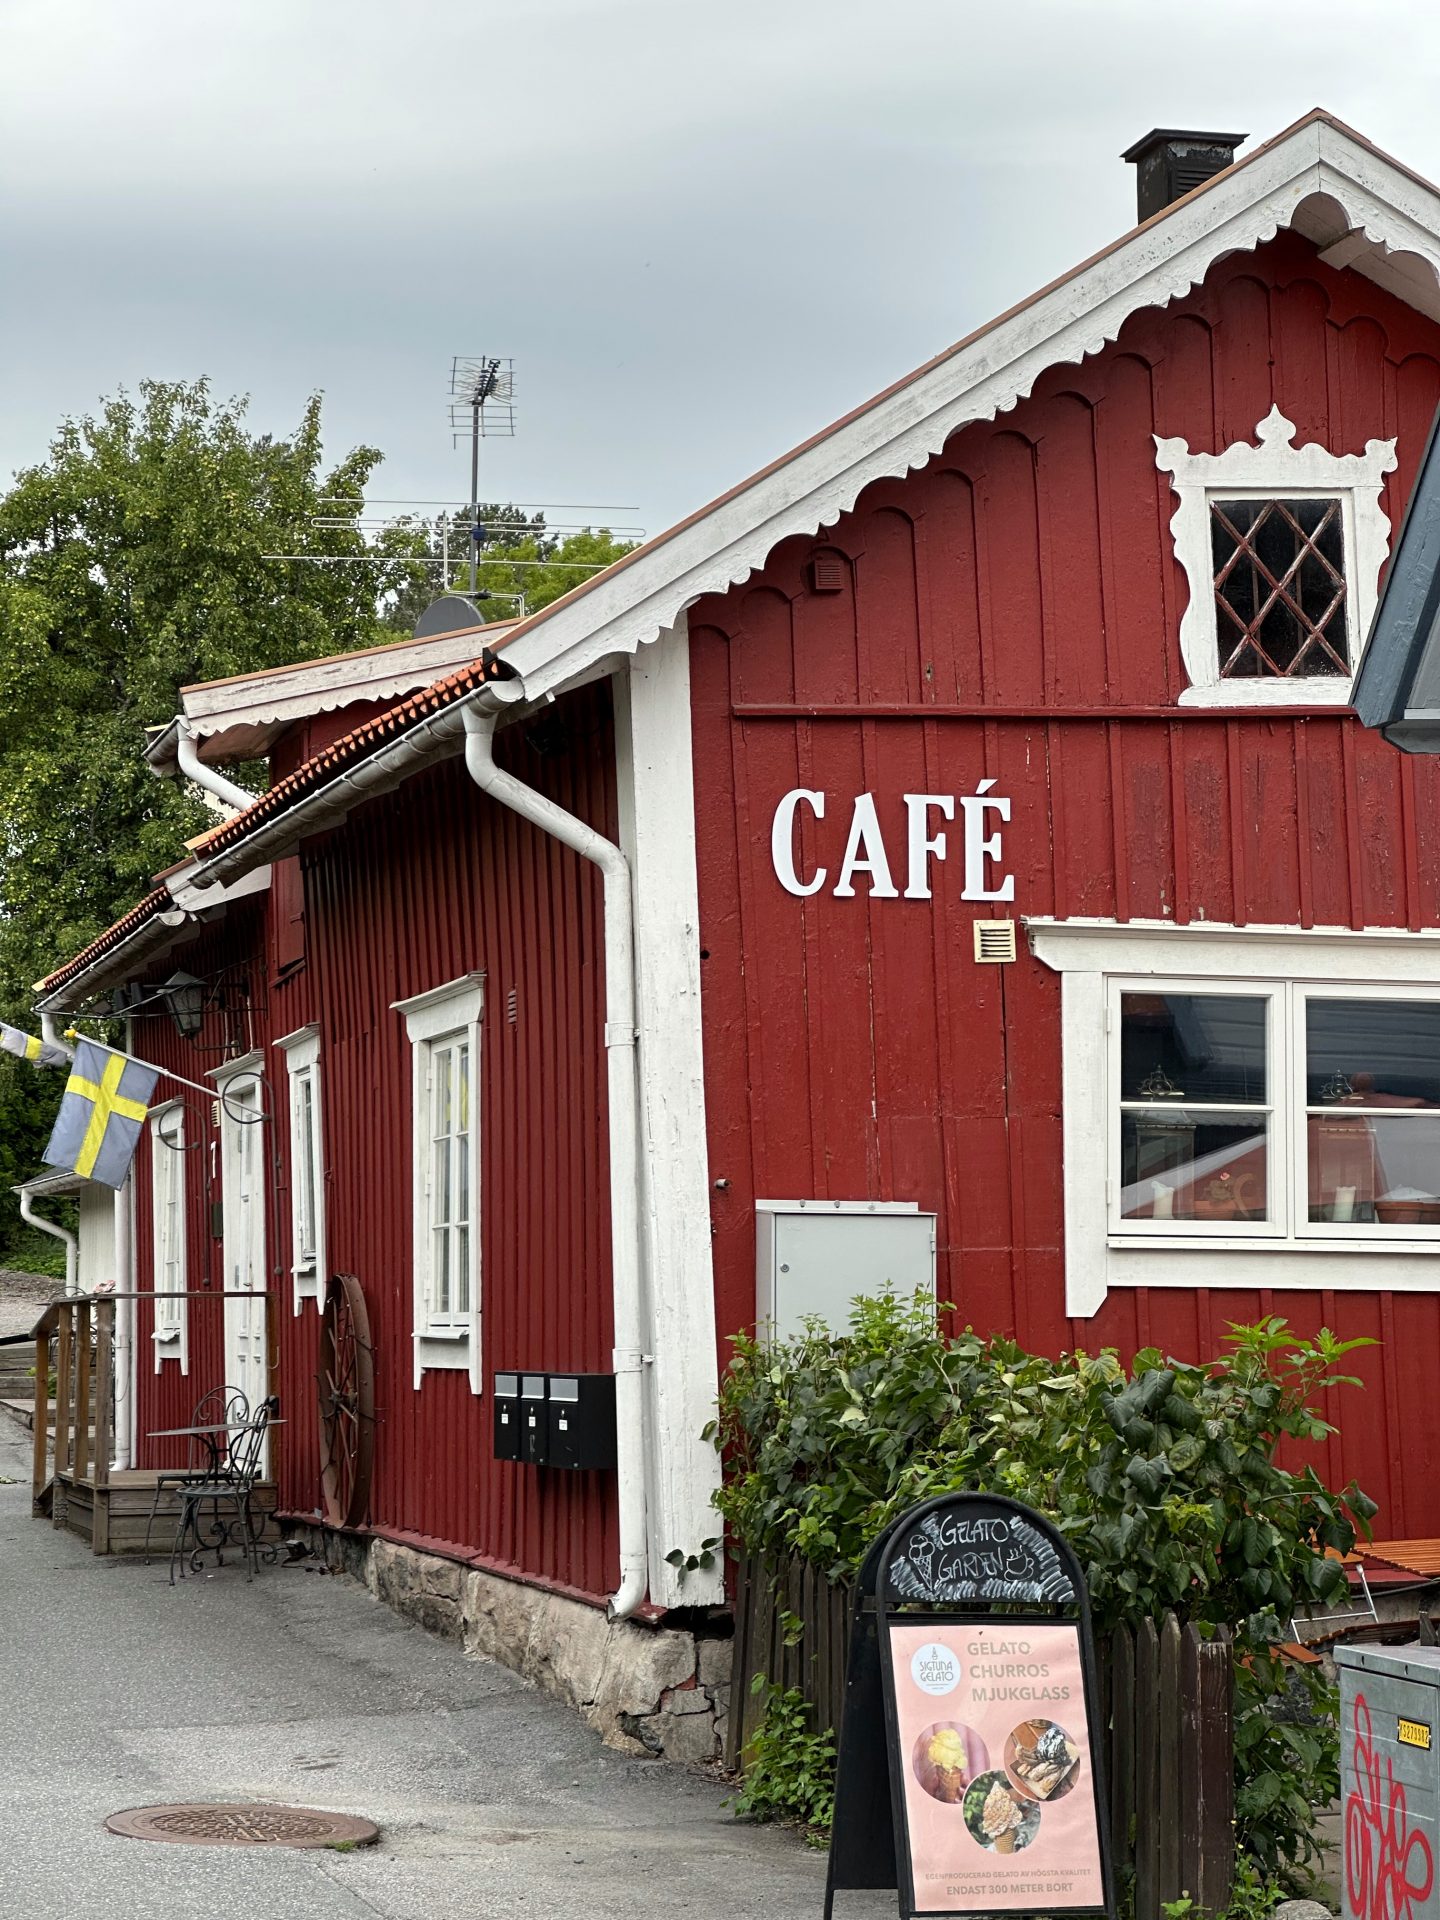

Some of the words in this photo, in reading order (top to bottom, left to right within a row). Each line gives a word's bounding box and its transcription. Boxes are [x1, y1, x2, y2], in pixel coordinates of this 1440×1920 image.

[771, 778, 1015, 902] CAFÉ
[939, 1514, 1010, 1546] GELATO
[937, 1547, 1004, 1582] GARDEN
[967, 1642, 1031, 1656] GELATO
[919, 1660, 953, 1672] SIGTUNA
[969, 1663, 1050, 1679] CHURROS
[919, 1671, 954, 1682] GELATO
[971, 1686, 1070, 1702] MJUKGLASS
[925, 1871, 992, 1880] EGENPRODUCERAD
[992, 1870, 1019, 1878] GELATO
[1020, 1870, 1031, 1878] AV
[1060, 1868, 1091, 1876] KVALITET
[946, 1885, 986, 1895] ENDAST
[988, 1884, 1008, 1894] 300
[1010, 1883, 1044, 1893] METER
[1046, 1882, 1074, 1893] BORT
